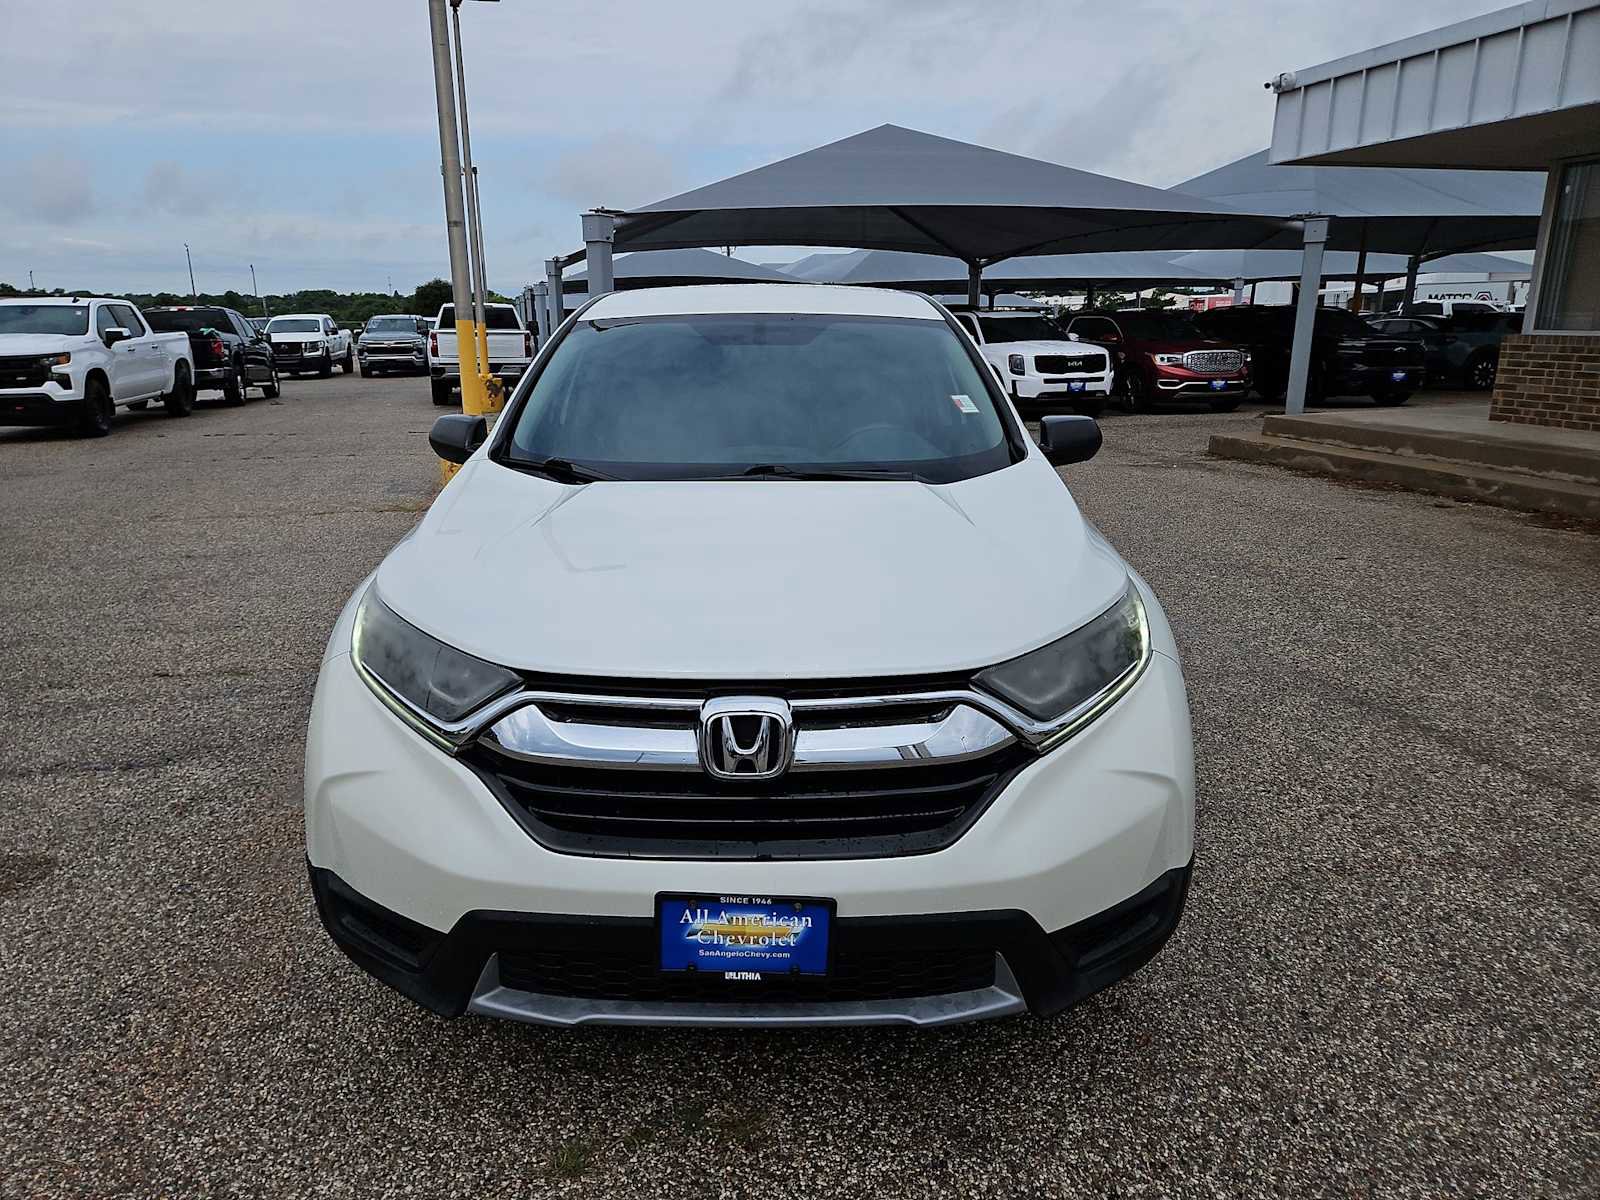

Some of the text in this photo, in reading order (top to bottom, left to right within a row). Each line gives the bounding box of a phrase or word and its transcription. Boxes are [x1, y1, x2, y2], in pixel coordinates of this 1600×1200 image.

[720, 896, 772, 905] SINCE 1946
[680, 909, 812, 928] All American
[697, 928, 797, 947] Chevrolet
[698, 949, 791, 959] SanAngeloChevy.com
